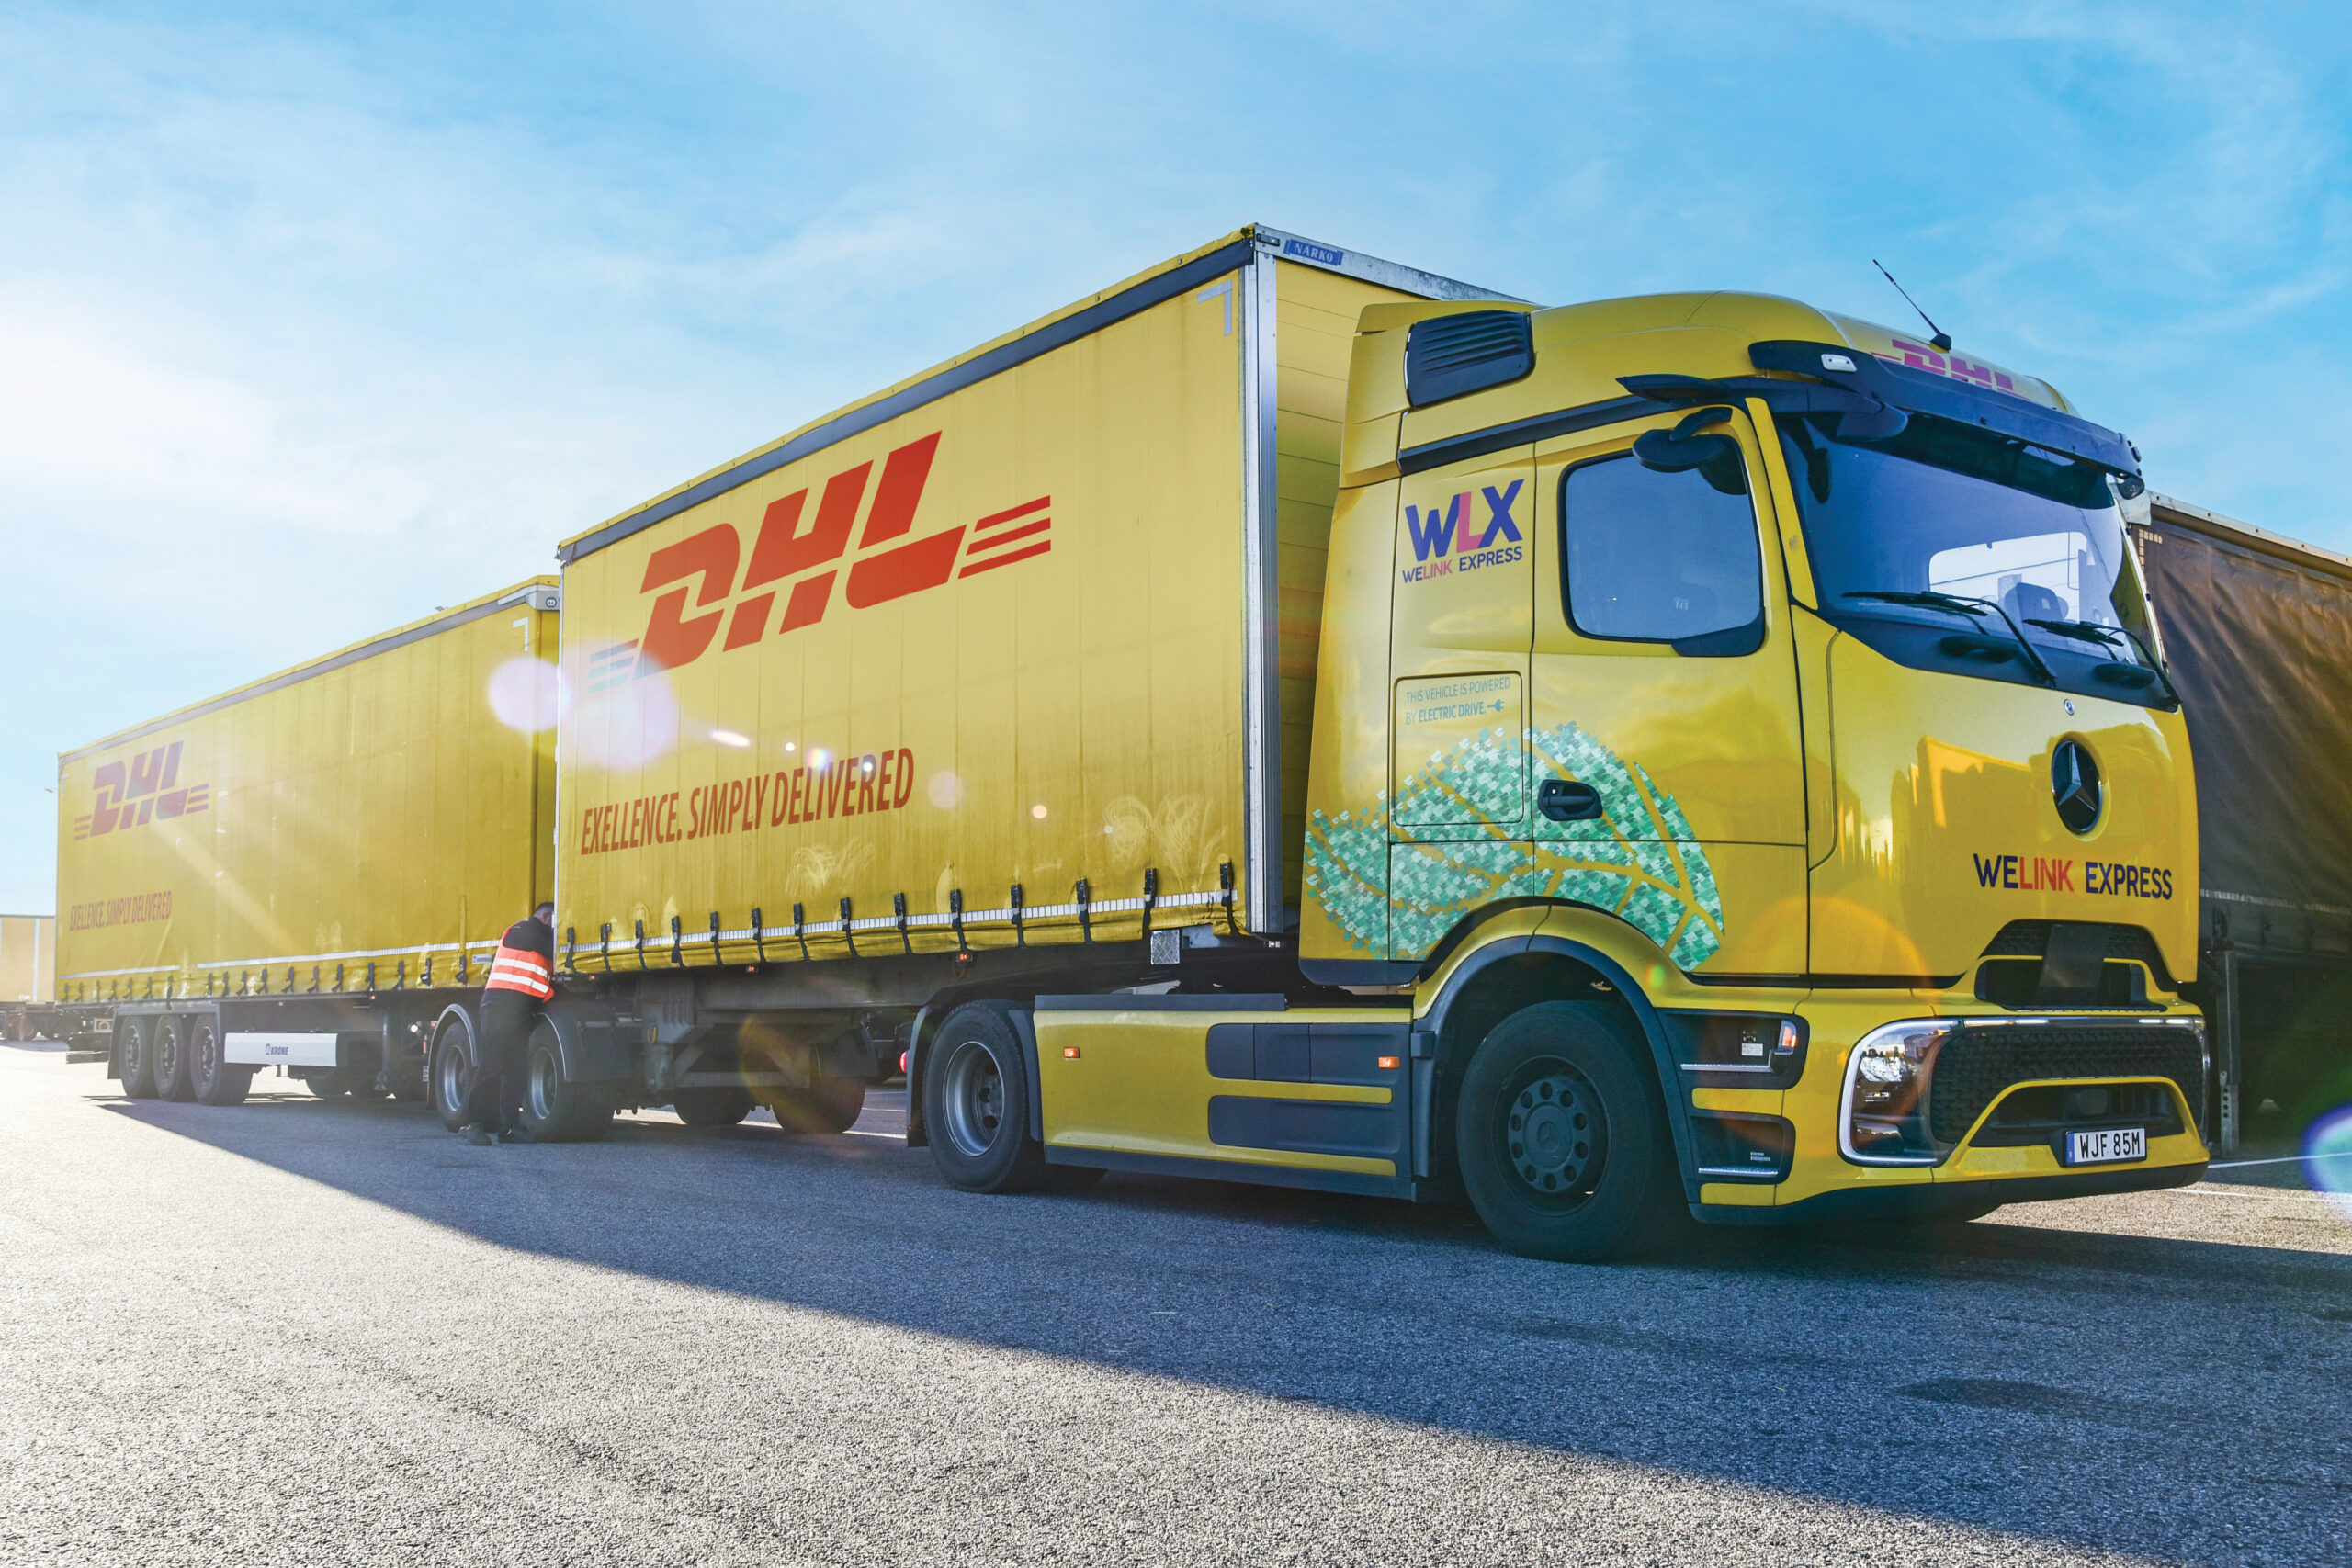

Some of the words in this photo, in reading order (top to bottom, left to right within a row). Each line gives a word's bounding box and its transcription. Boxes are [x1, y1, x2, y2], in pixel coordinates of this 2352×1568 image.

[1405, 479, 1524, 562] WLX
[632, 430, 967, 681] DHL
[1402, 559, 1453, 584] WELINK
[1459, 546, 1523, 572] EXPRESS
[1406, 689, 1423, 704] THIS
[1425, 683, 1458, 701] VEHICLE
[1460, 682, 1468, 696] IS
[1470, 676, 1511, 694] POWERED
[1406, 711, 1418, 725] BY
[1419, 705, 1457, 723] ELECTRIC
[1458, 701, 1487, 717] DRIVE.
[89, 740, 189, 838] DHL
[581, 792, 683, 855] EXELLENCE.
[687, 773, 770, 840] SIMPLY
[770, 747, 914, 828] DELIVERED
[1973, 853, 2075, 892] WELINK
[2086, 862, 2173, 900] EXPRESS
[107, 896, 132, 927] SIMPLY
[131, 890, 173, 923] DELIVERED
[2080, 1133, 2108, 1159] WJF
[2113, 1131, 2141, 1156] 85M
